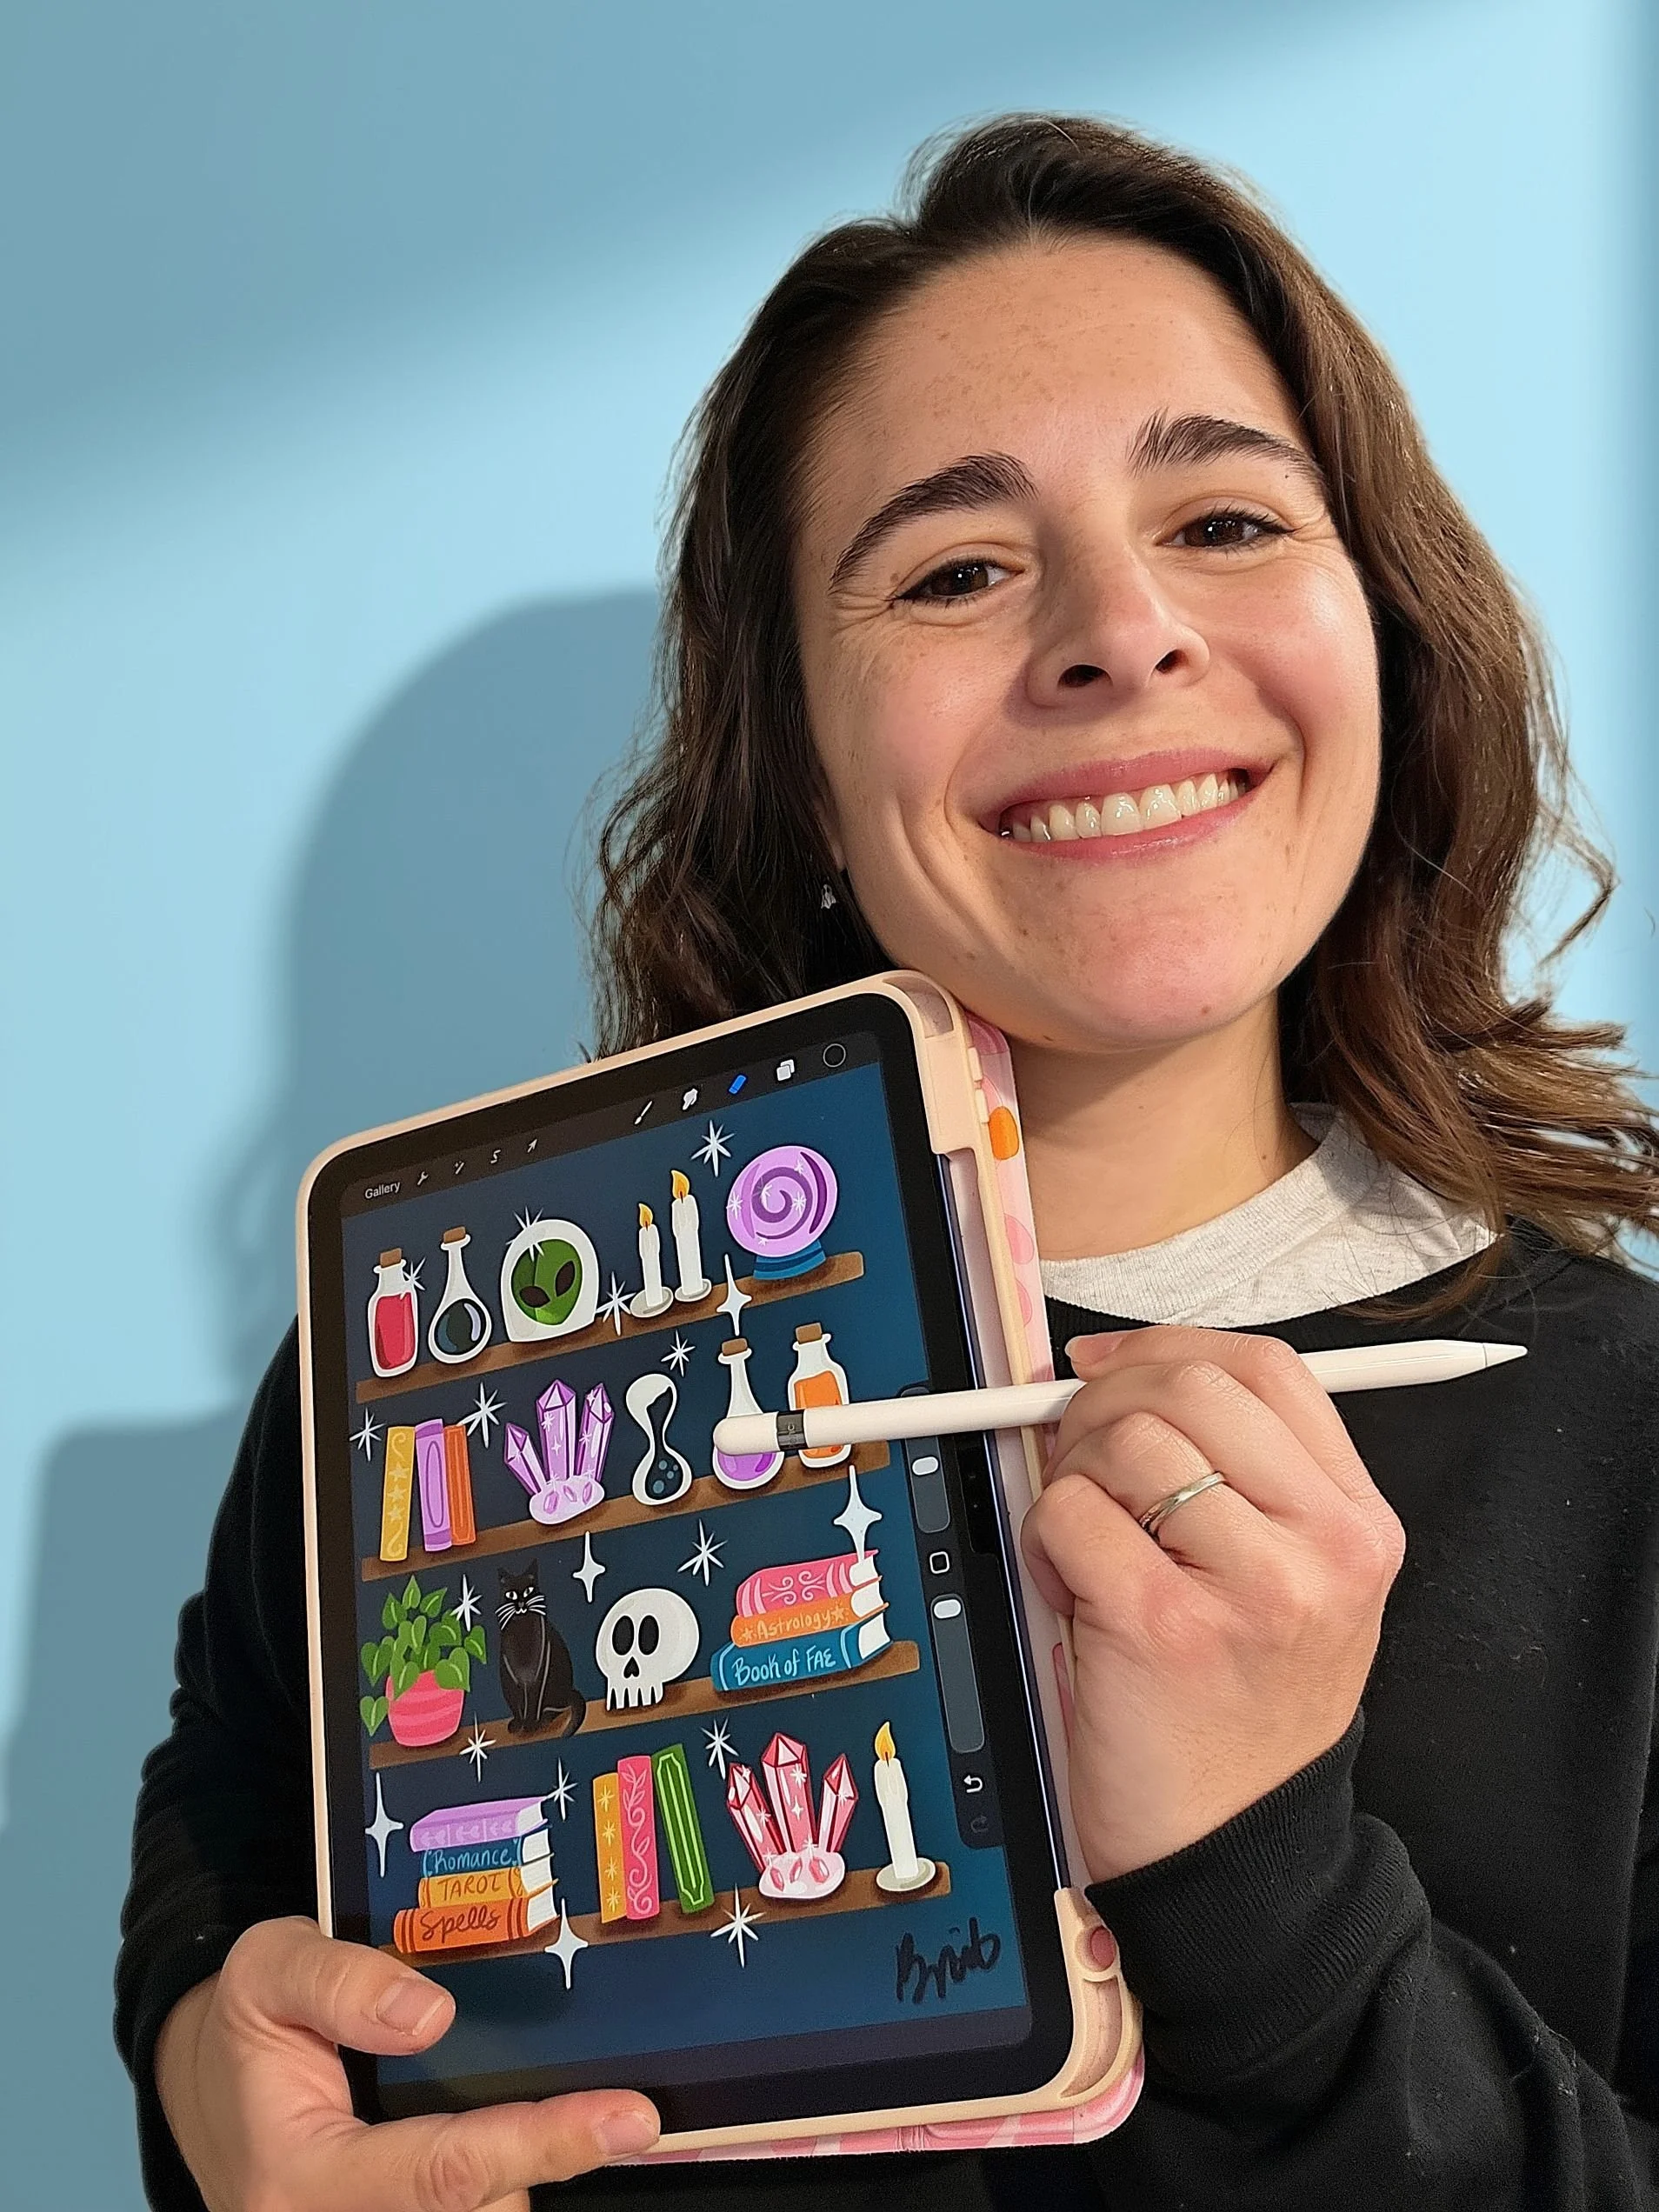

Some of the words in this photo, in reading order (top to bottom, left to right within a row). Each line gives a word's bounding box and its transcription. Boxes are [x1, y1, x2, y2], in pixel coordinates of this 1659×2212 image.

[364, 1182, 401, 1200] Gallery
[757, 1609, 831, 1639] Astrology
[731, 1654, 781, 1685] Book
[784, 1649, 799, 1676] of
[435, 1848, 512, 1873] Romance
[438, 1871, 505, 1901] TAROT
[420, 1905, 501, 1943] Spells
